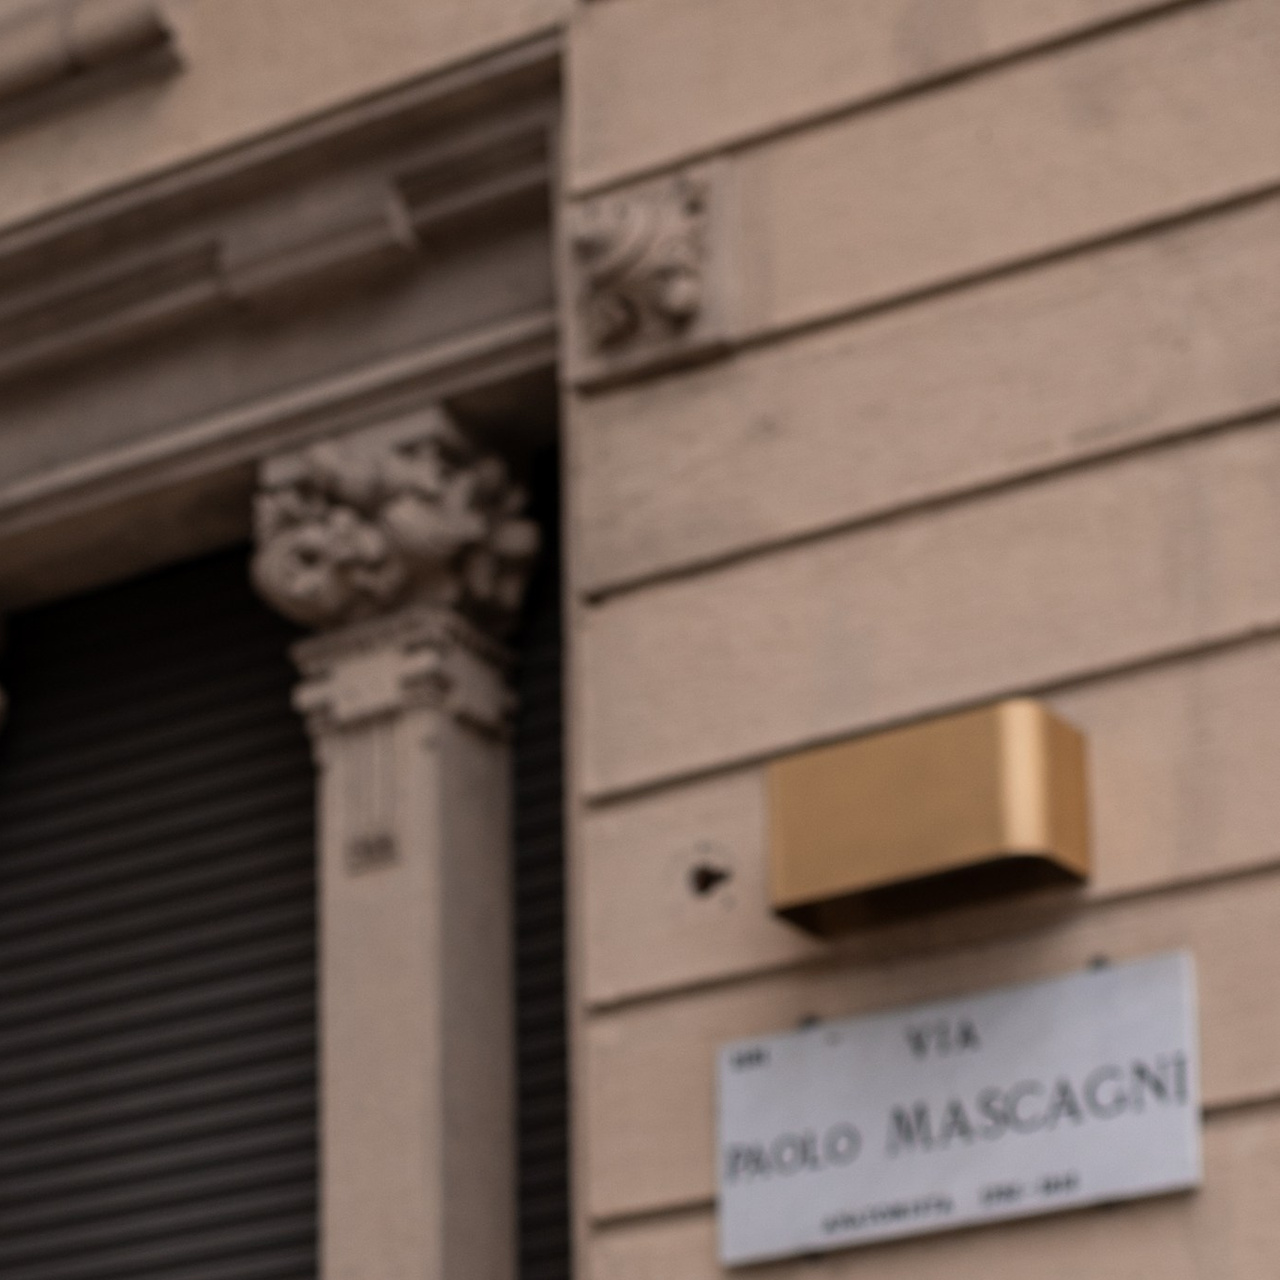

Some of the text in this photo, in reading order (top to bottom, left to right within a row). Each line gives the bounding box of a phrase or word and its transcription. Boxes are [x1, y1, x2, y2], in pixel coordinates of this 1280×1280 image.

[907, 1018, 981, 1058] VIA
[726, 1052, 1189, 1184] PAOLO MASCAGNI
